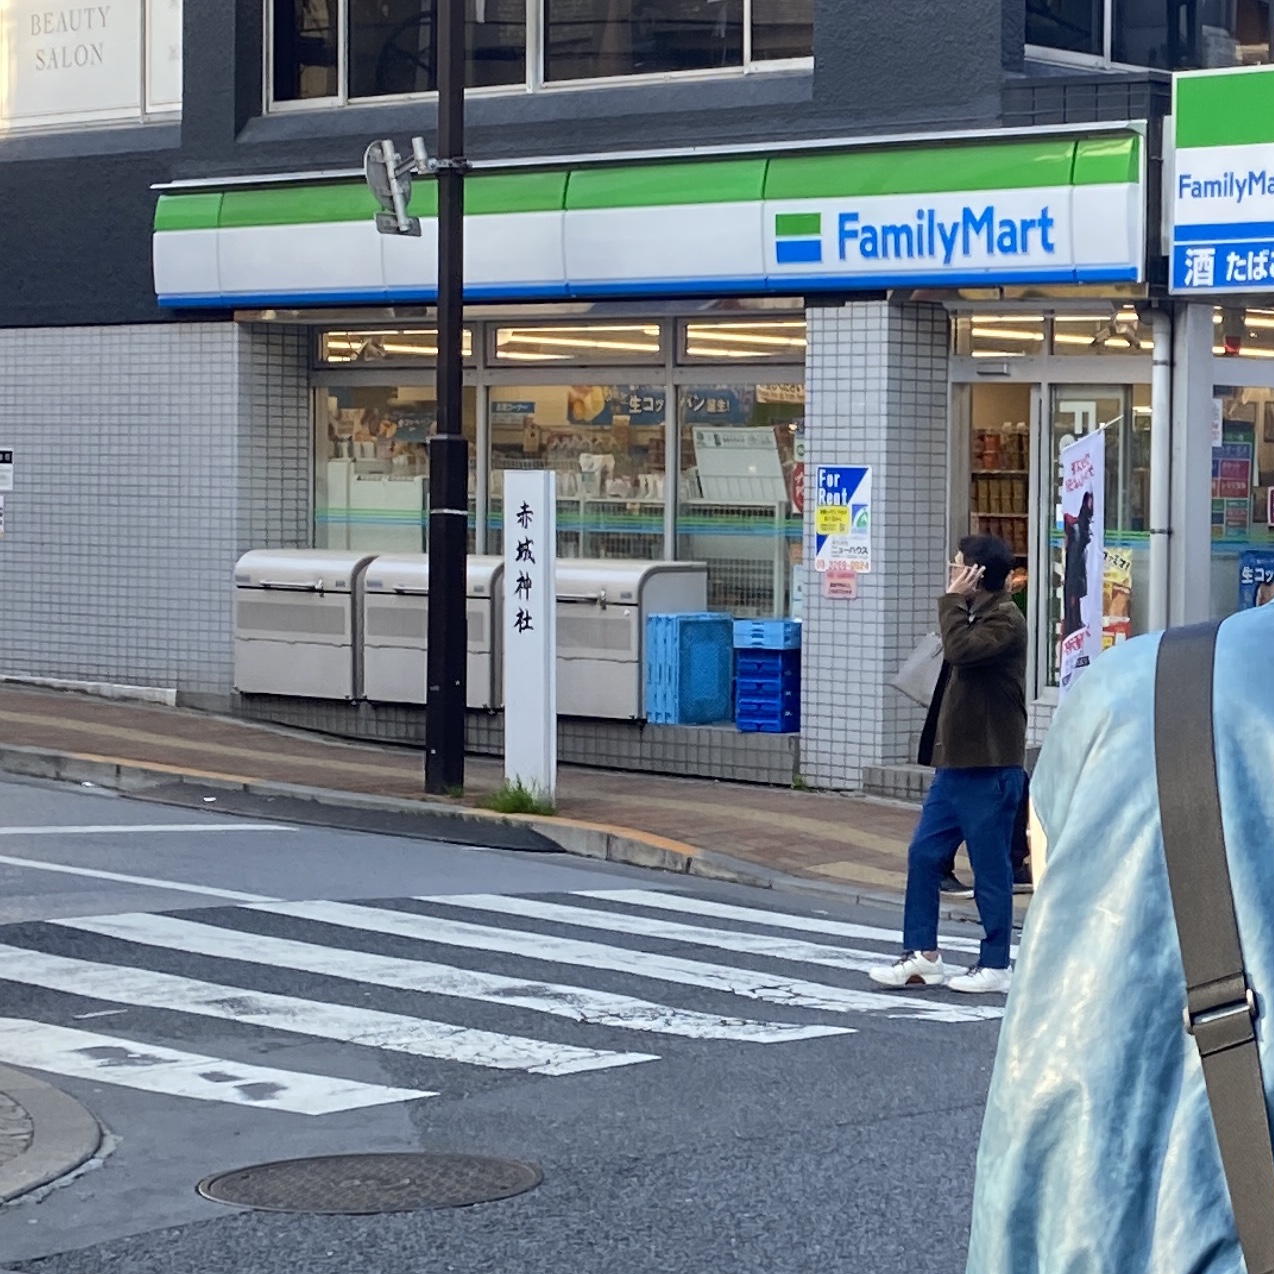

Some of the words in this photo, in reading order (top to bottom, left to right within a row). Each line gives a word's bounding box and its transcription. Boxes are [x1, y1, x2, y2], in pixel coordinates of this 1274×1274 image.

[30, 5, 111, 36] BEAUTY
[35, 42, 104, 71] SALON
[838, 205, 1055, 266] FamilyMart
[1184, 247, 1216, 287] 酒
[819, 469, 841, 487] For
[819, 488, 847, 506] Rent
[513, 500, 537, 634] 赤城神社
